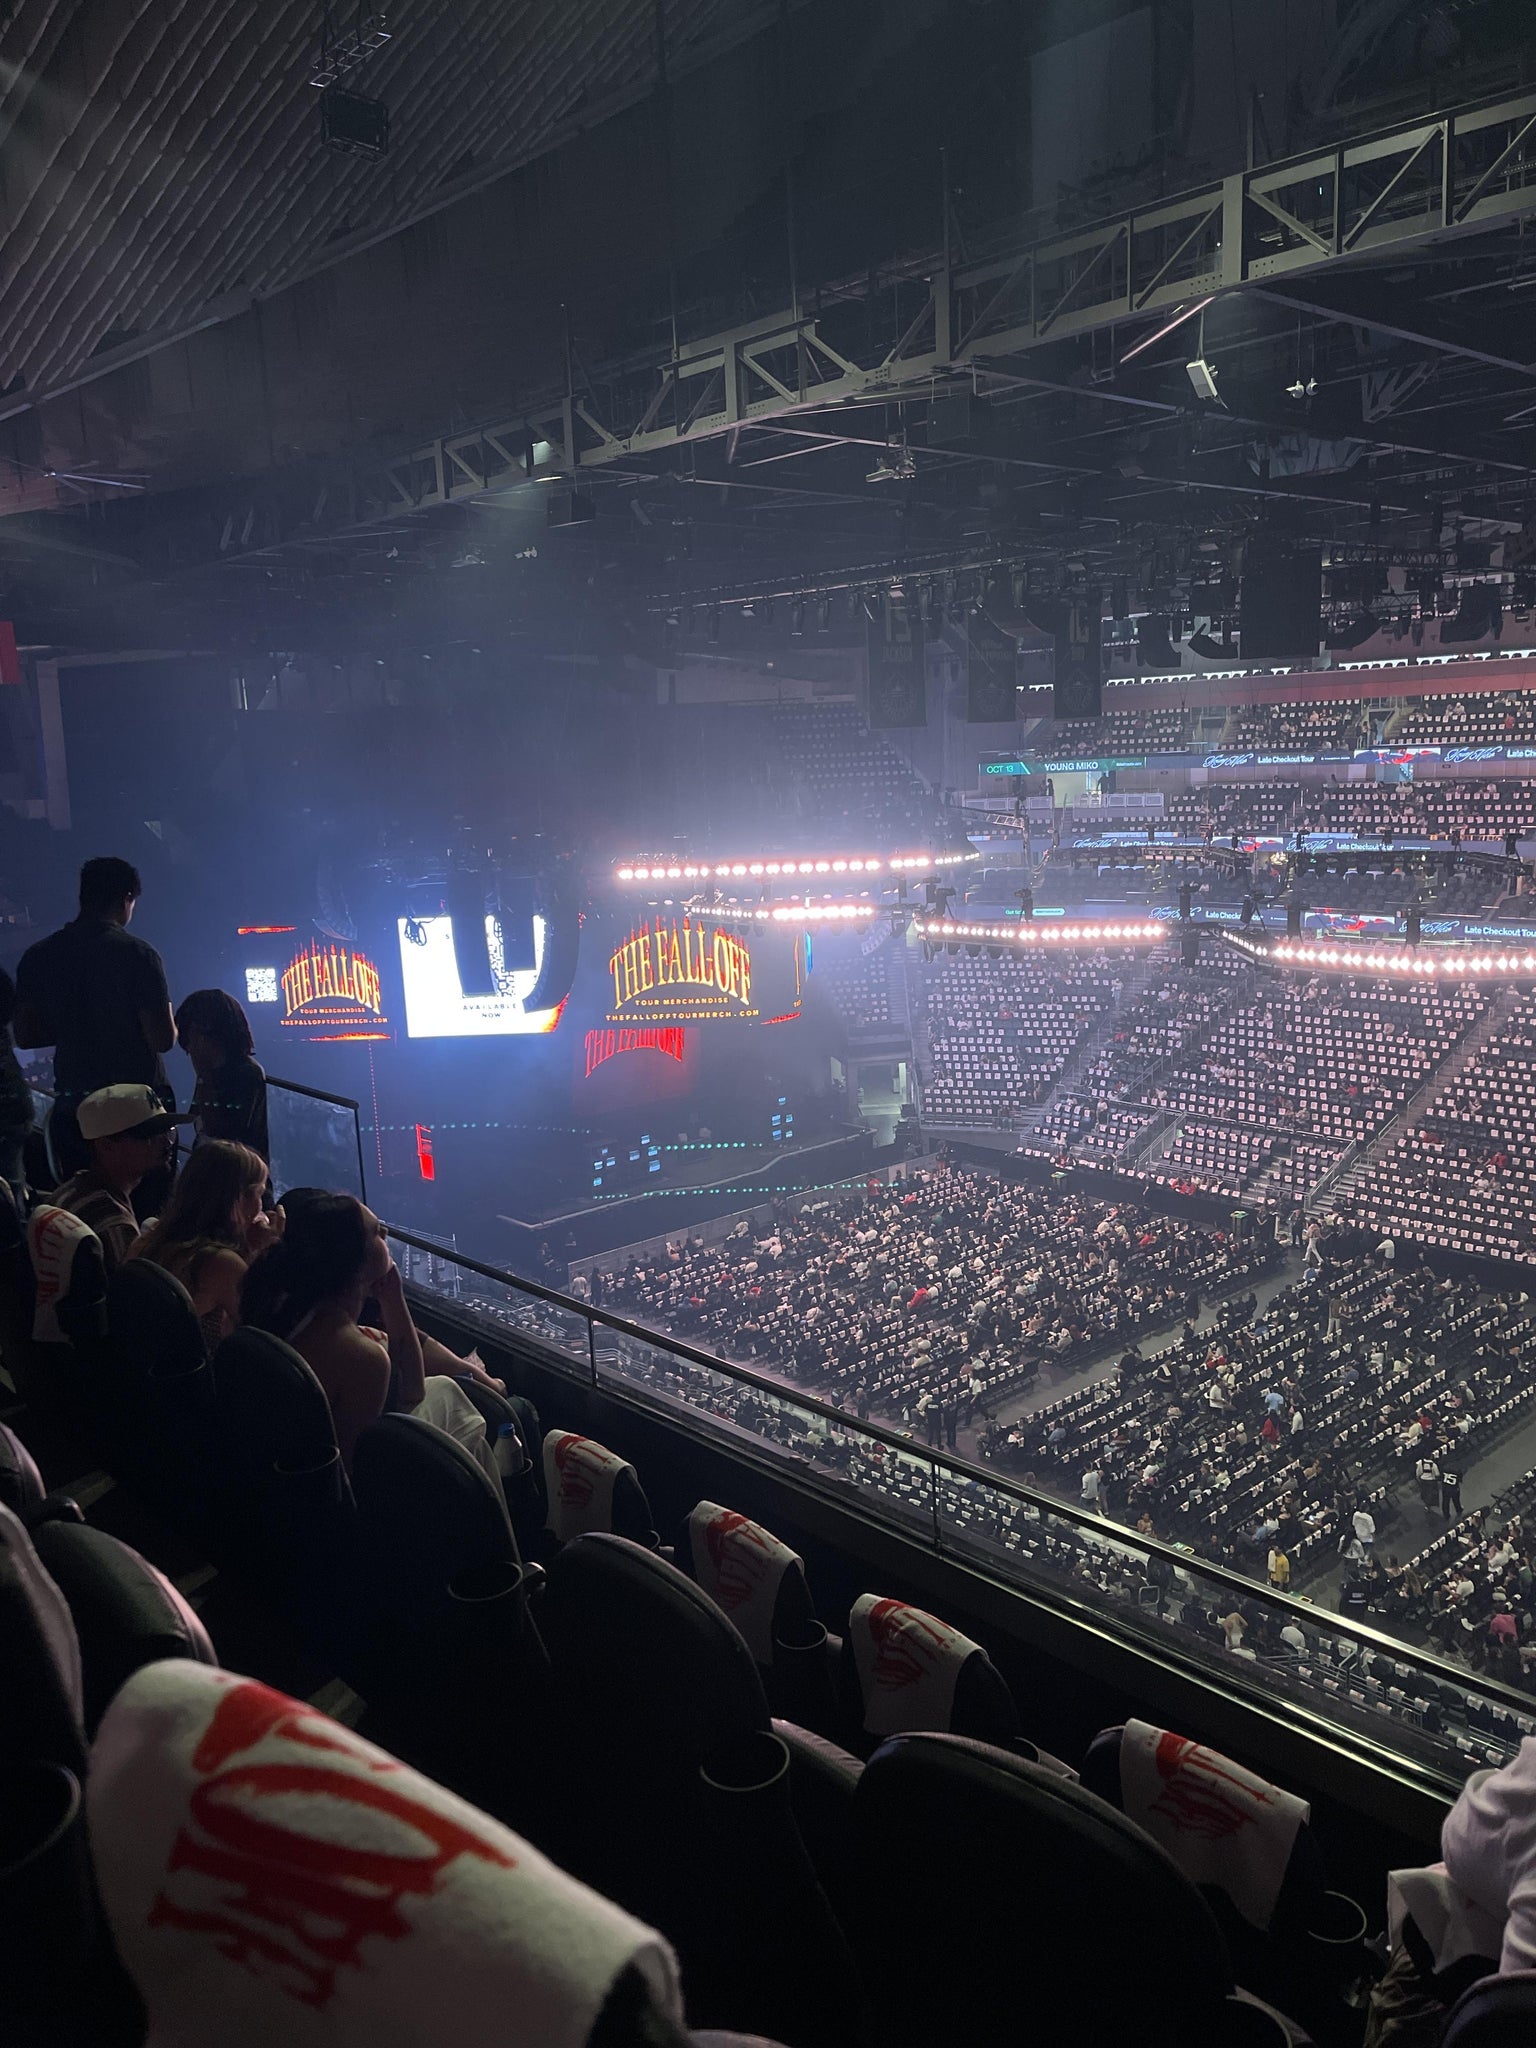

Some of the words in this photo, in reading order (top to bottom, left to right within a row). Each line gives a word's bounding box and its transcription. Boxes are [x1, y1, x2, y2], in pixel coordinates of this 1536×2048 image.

[1507, 749, 1523, 757] Late
[986, 765, 1002, 773] OCT
[1006, 765, 1014, 773] 13
[1044, 762, 1074, 771] YOUNG
[1076, 761, 1098, 770] MIKO
[1465, 925, 1482, 934] Late
[1483, 927, 1520, 936] Checkout
[609, 934, 654, 1009] THE
[654, 928, 751, 1006] FALL-OFF
[281, 957, 313, 1016] THE
[311, 954, 381, 1015] FALL-OFF
[663, 997, 729, 1005] MERCHANDISE
[1442, 1472, 1458, 1485] 15
